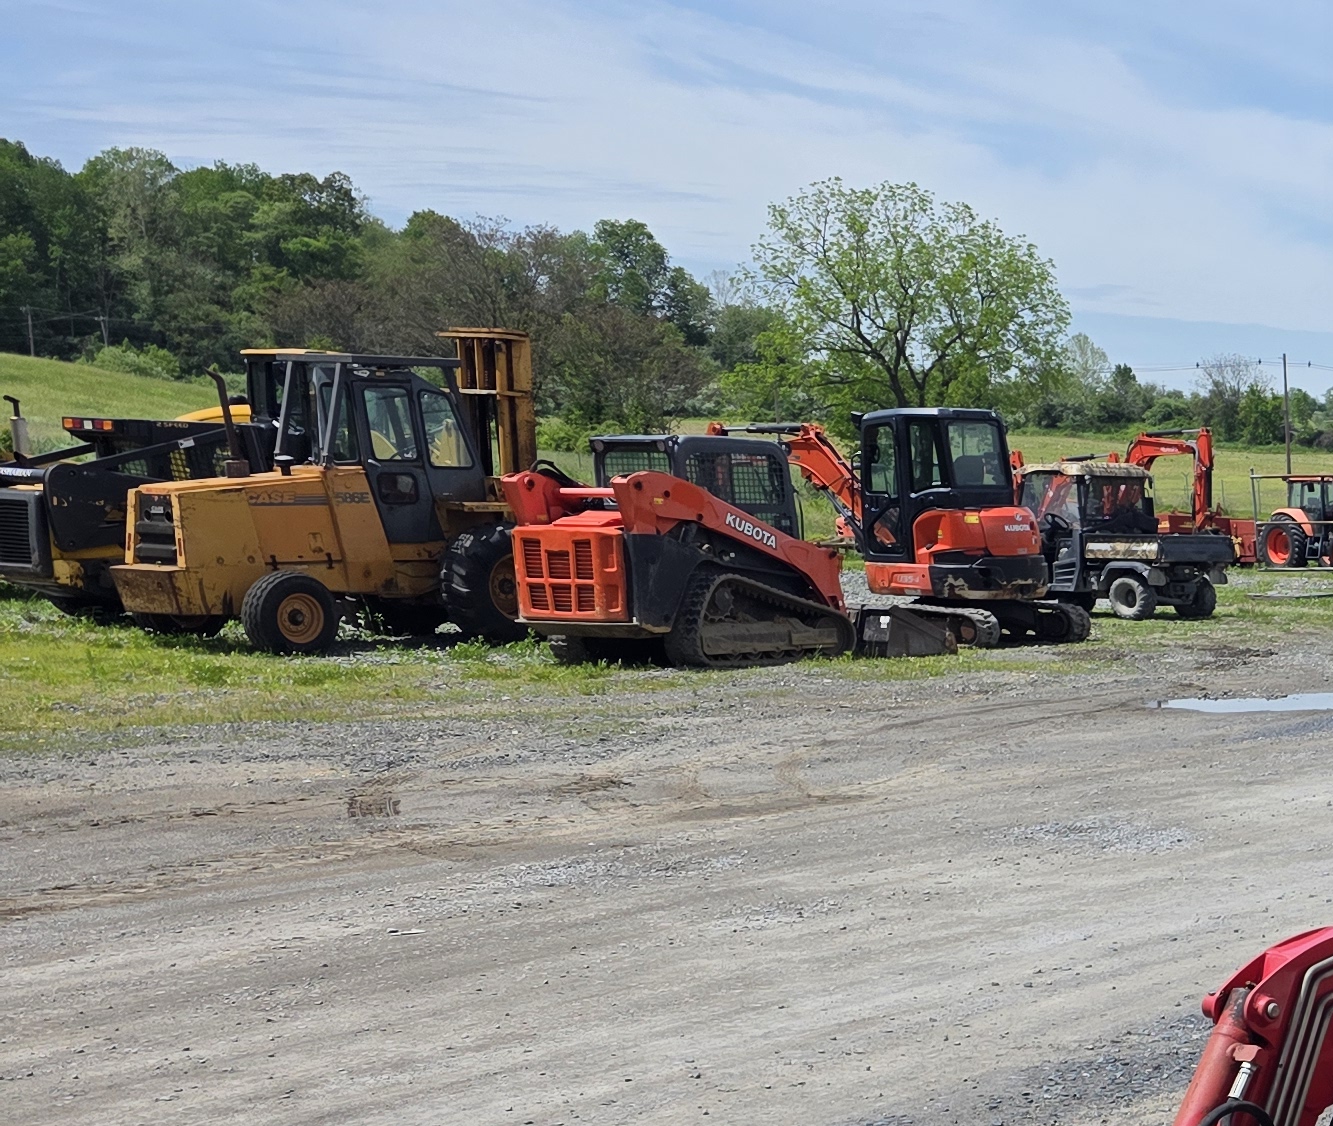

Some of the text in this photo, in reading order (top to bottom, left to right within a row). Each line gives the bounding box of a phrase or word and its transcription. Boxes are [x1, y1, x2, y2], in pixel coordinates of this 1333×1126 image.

[246, 490, 296, 505] CASE
[334, 491, 371, 504] 586E
[725, 512, 776, 549] KUBOTA
[1004, 524, 1030, 532] KUBOTA
